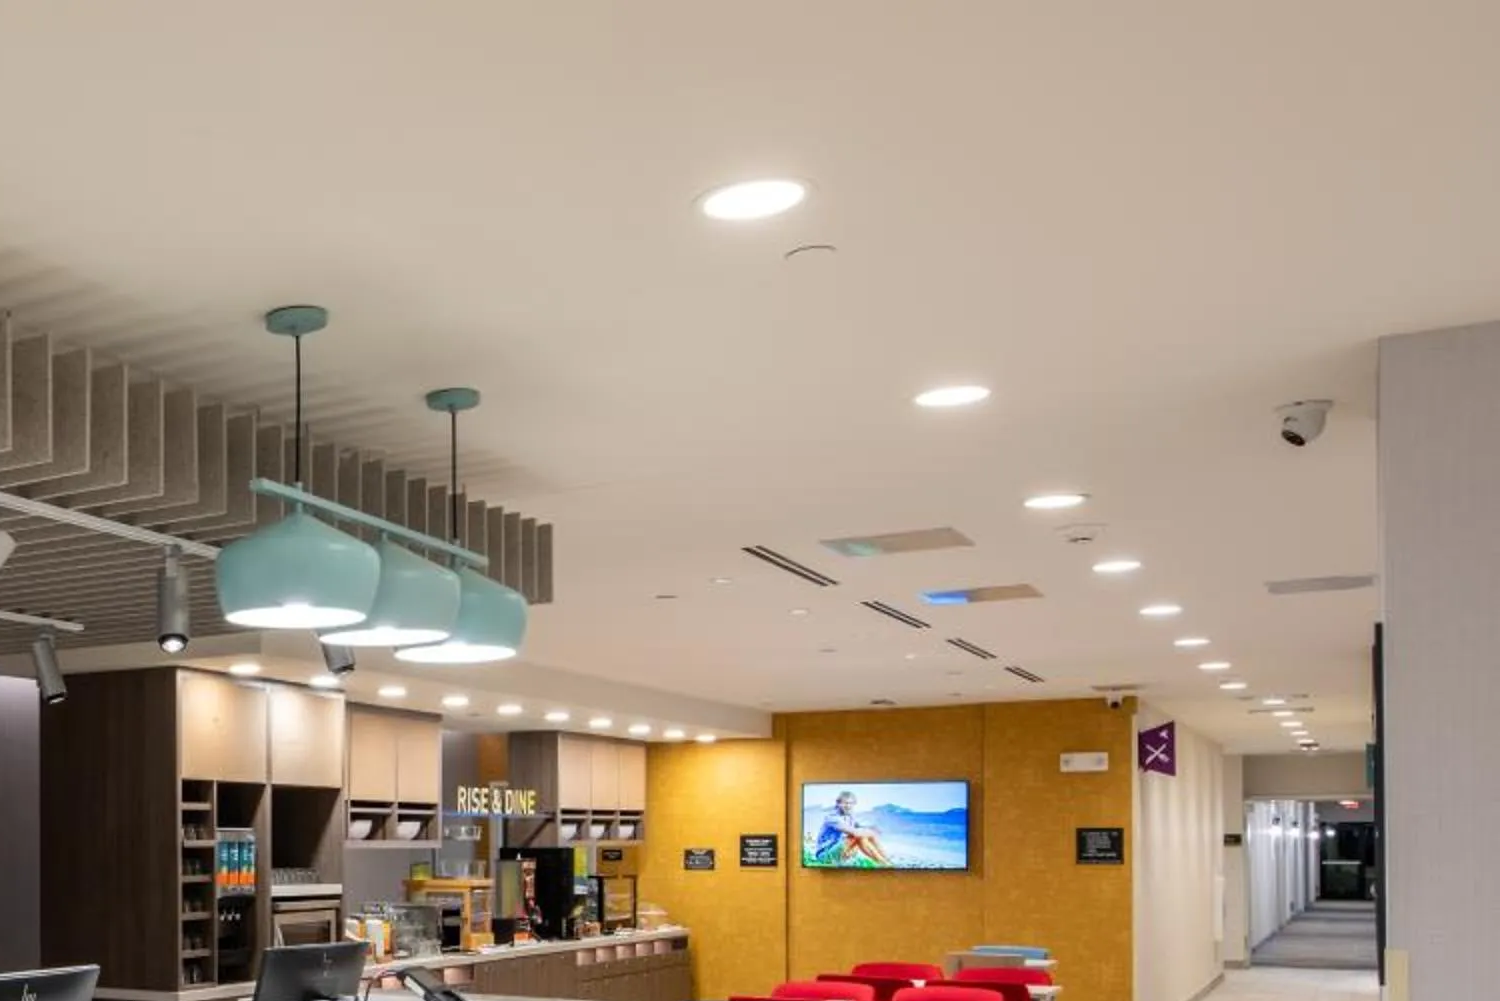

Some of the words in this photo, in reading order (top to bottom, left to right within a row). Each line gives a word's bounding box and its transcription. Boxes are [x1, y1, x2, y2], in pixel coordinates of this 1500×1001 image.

[457, 786, 489, 815] RISE
[491, 788, 503, 815] &
[504, 789, 537, 815] DINE
